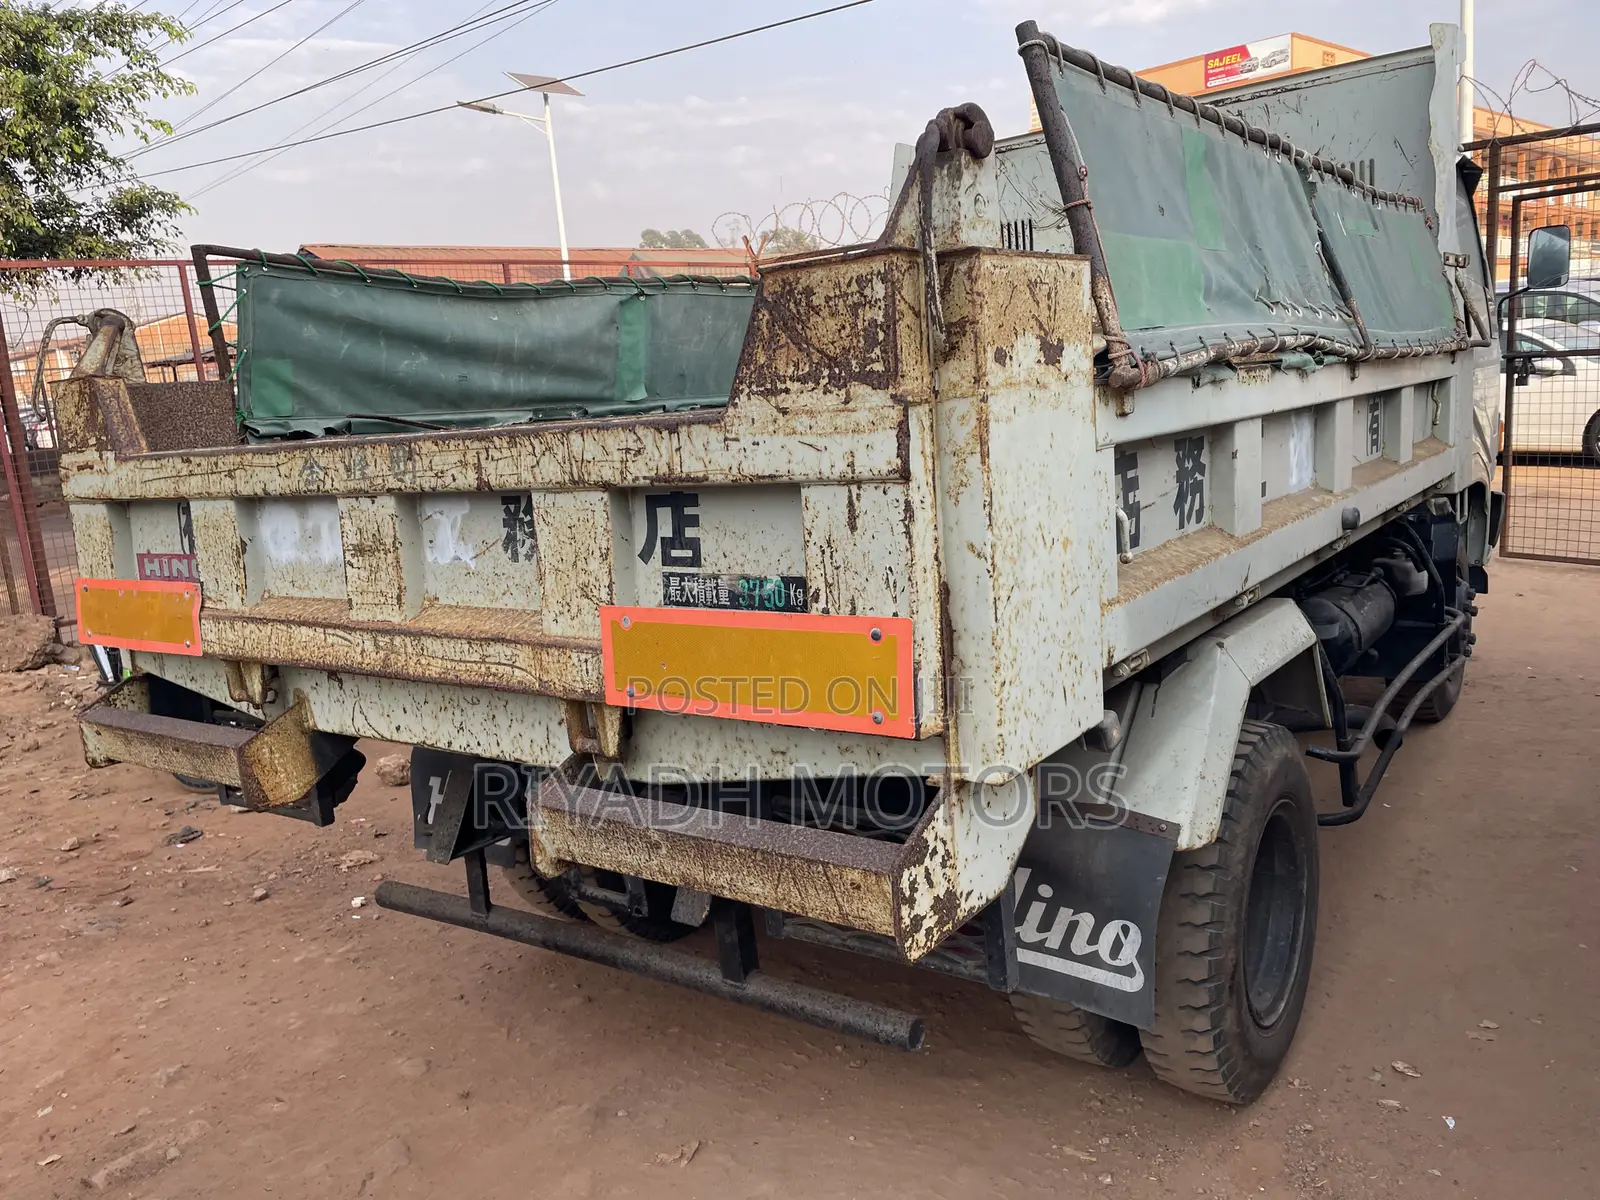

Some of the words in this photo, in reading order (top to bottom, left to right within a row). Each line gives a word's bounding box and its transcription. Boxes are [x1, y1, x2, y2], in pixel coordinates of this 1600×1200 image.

[1207, 53, 1242, 69] SAJEEL
[637, 491, 701, 568] 店
[666, 576, 731, 605] 最大積載量
[737, 577, 786, 608] 3750
